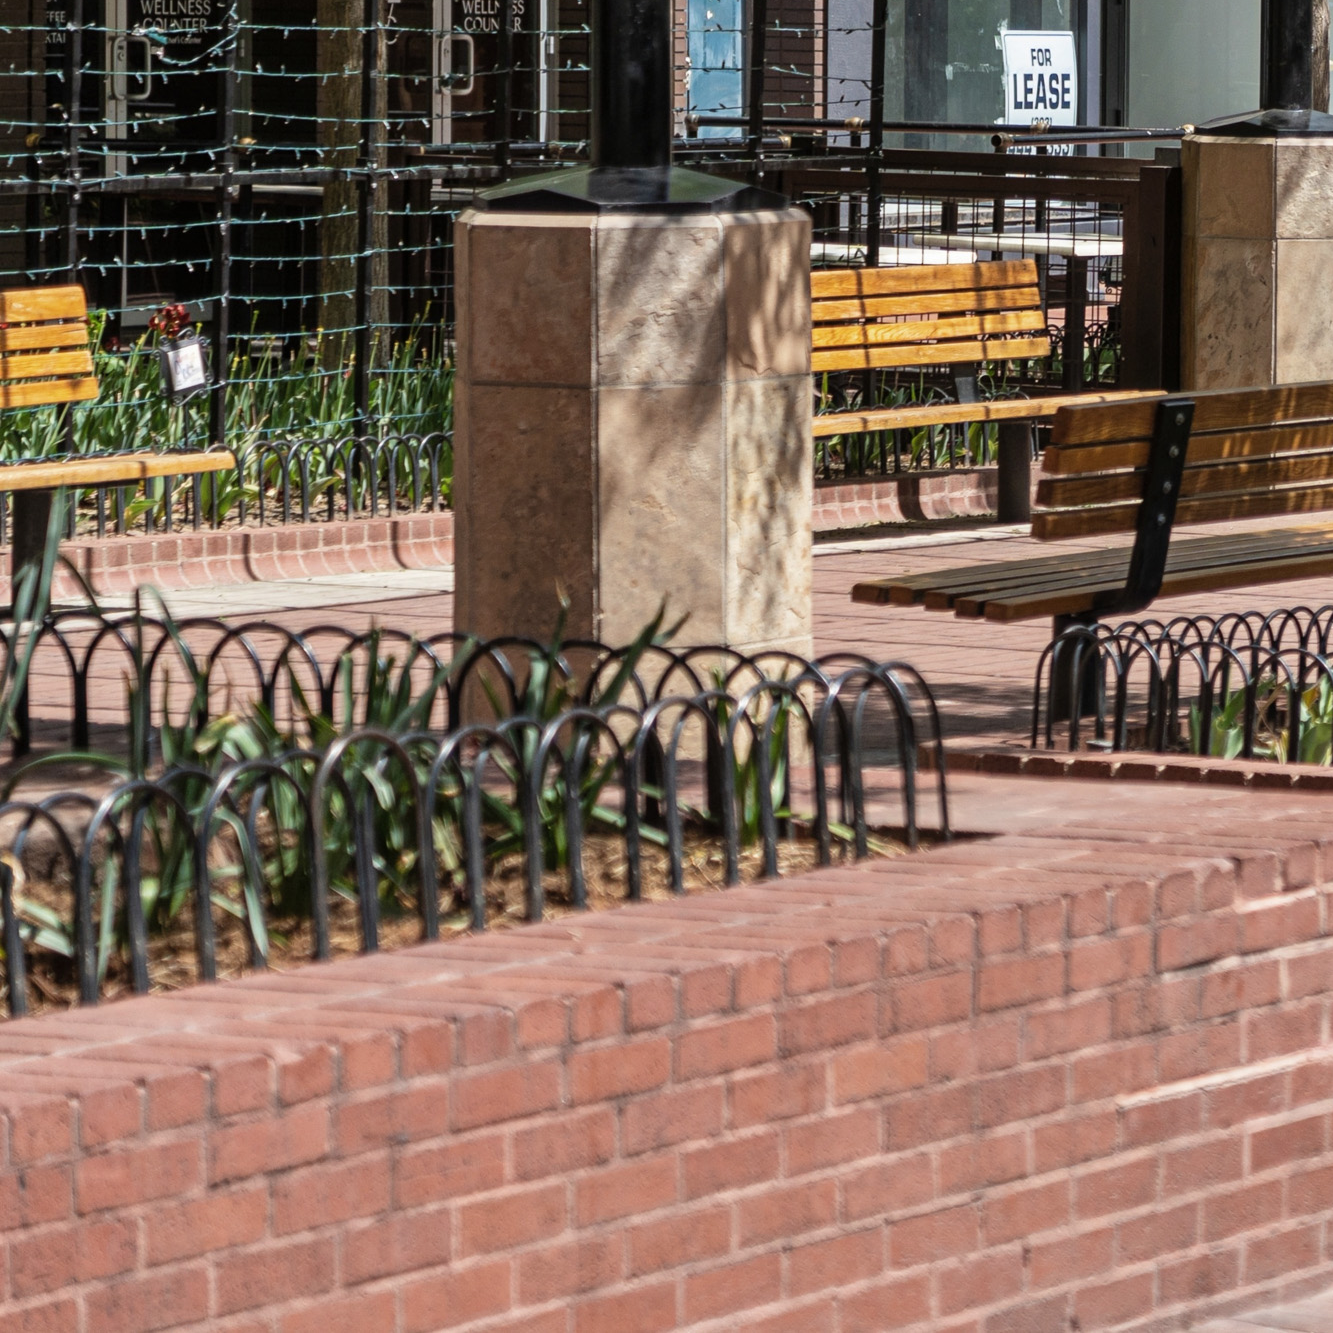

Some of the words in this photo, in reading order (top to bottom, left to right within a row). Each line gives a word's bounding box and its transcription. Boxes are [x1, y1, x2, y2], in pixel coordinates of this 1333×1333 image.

[140, 0, 211, 15] WELLNESS
[462, 0, 525, 15] WELLNSS
[142, 17, 208, 34] COUNTER
[464, 17, 522, 33] COUNR
[1030, 48, 1052, 67] FOR
[1013, 72, 1071, 110] LEASE
